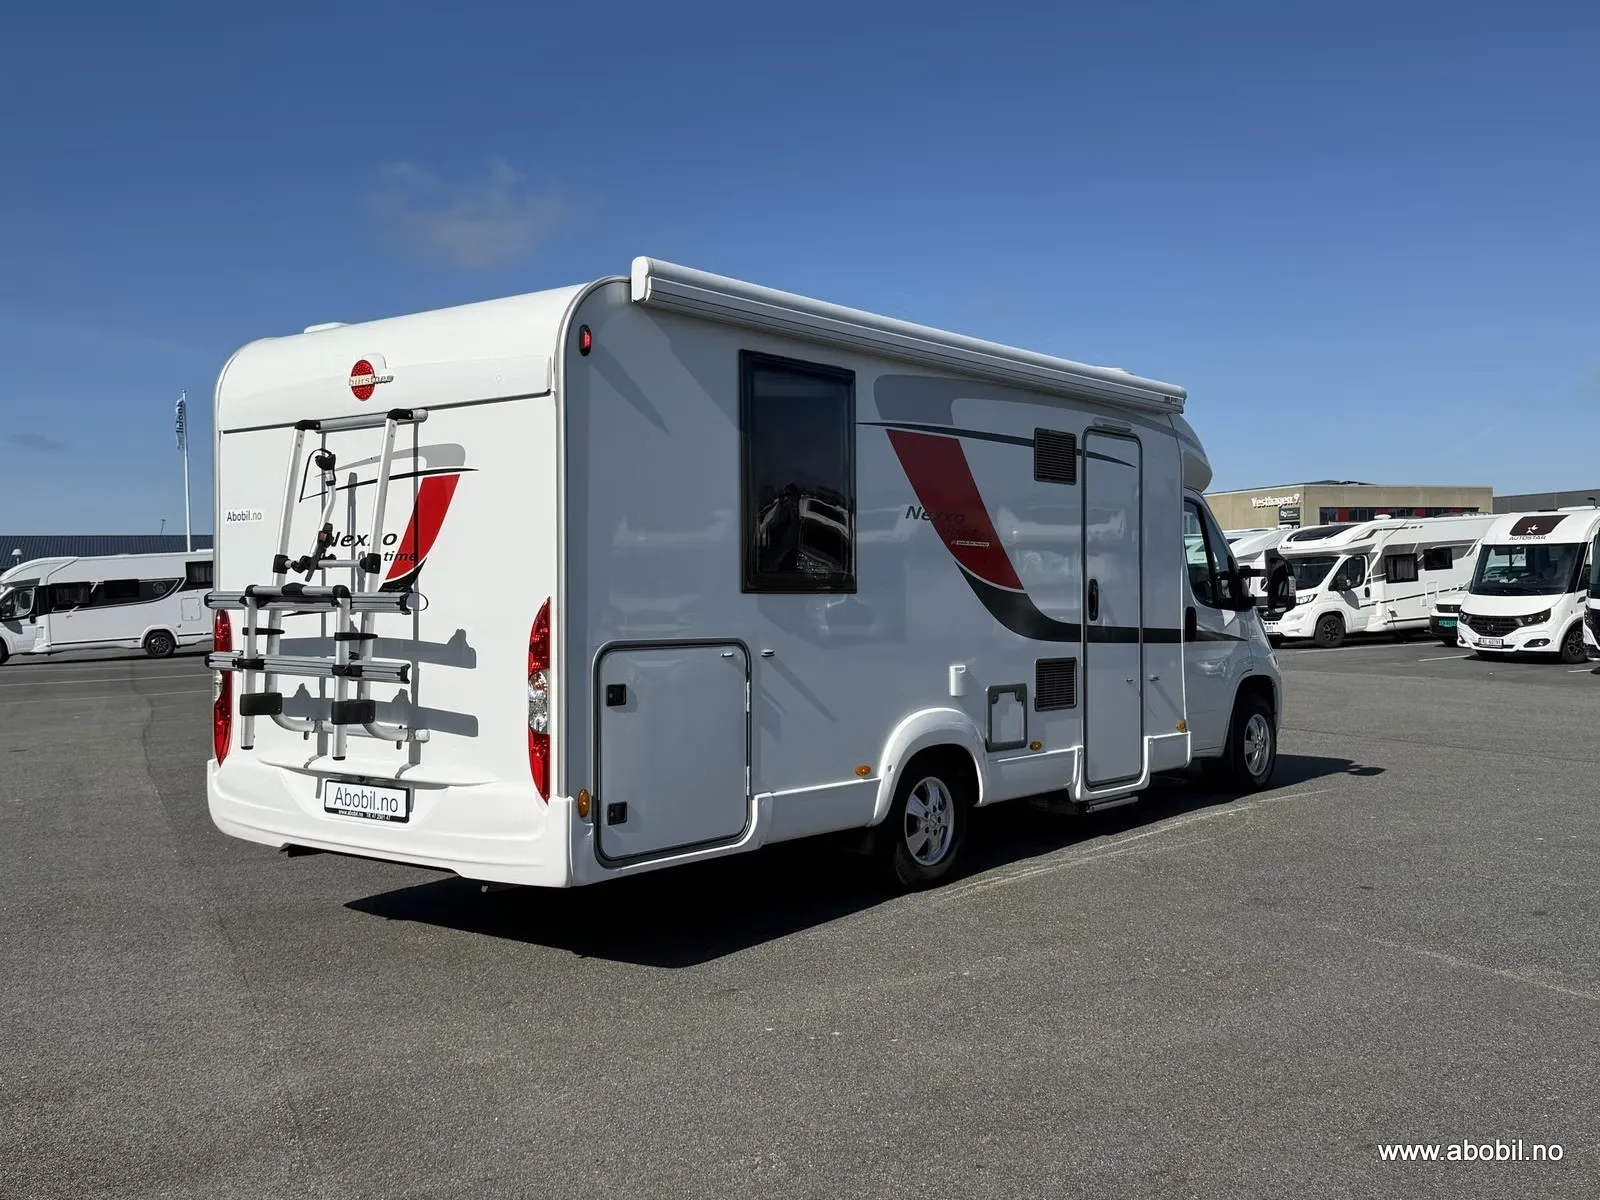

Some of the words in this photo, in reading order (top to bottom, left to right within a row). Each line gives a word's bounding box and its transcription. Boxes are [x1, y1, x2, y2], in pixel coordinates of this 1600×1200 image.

[226, 510, 262, 522] Abobil.no
[330, 531, 398, 547] exo
[383, 551, 416, 562] time
[334, 786, 399, 813] Abobil.no
